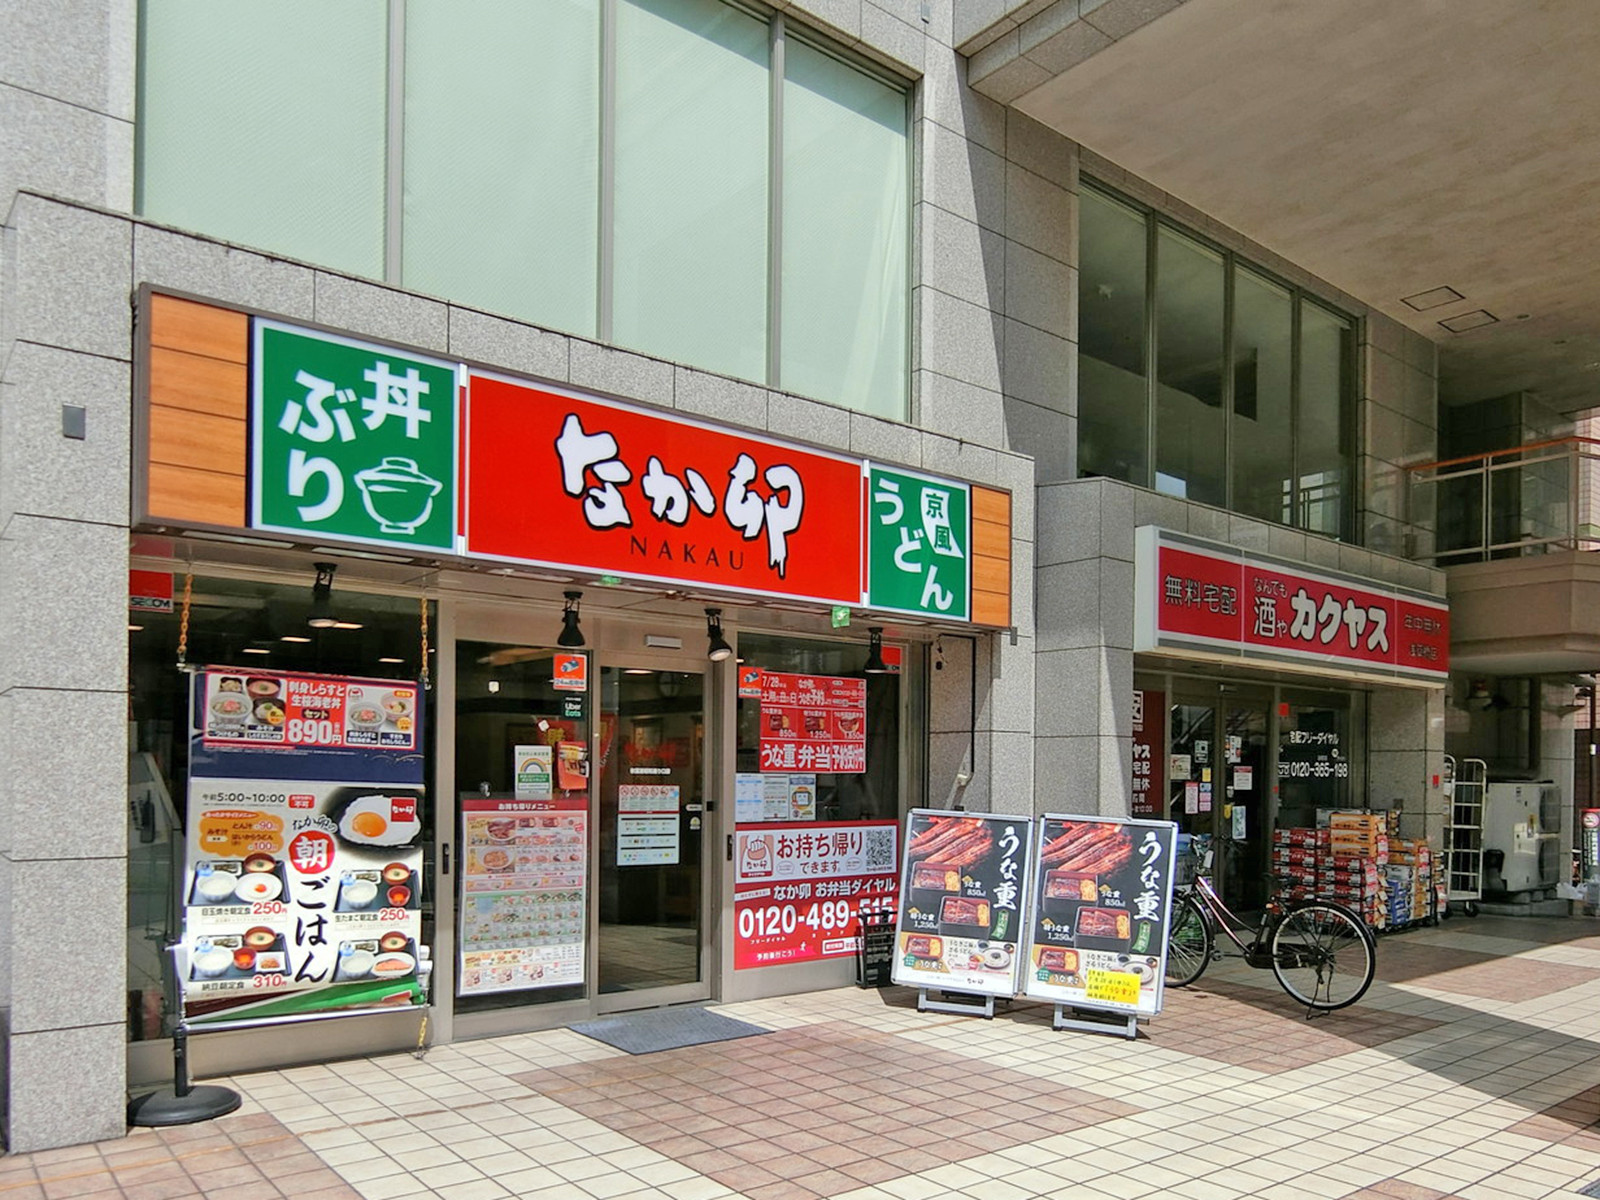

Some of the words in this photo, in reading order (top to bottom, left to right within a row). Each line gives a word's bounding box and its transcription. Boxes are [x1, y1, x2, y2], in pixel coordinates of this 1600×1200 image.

[554, 413, 805, 579] なか卯
[925, 492, 953, 552] 京風
[631, 535, 745, 571] NAKAU
[874, 480, 954, 610] うどん
[1164, 574, 1238, 616] 無料宅配
[1253, 577, 1288, 598] なんでも
[1289, 588, 1390, 653] カクヤス
[304, 709, 329, 719] セット
[565, 702, 581, 710] Uber
[1290, 761, 1348, 778] 0120-365-198
[776, 831, 863, 858] お持ち帰り
[993, 825, 1021, 911] うな重
[1133, 831, 1162, 922] うな重
[774, 883, 811, 900] なか卯
[816, 878, 897, 898] お弁当ダイヤル
